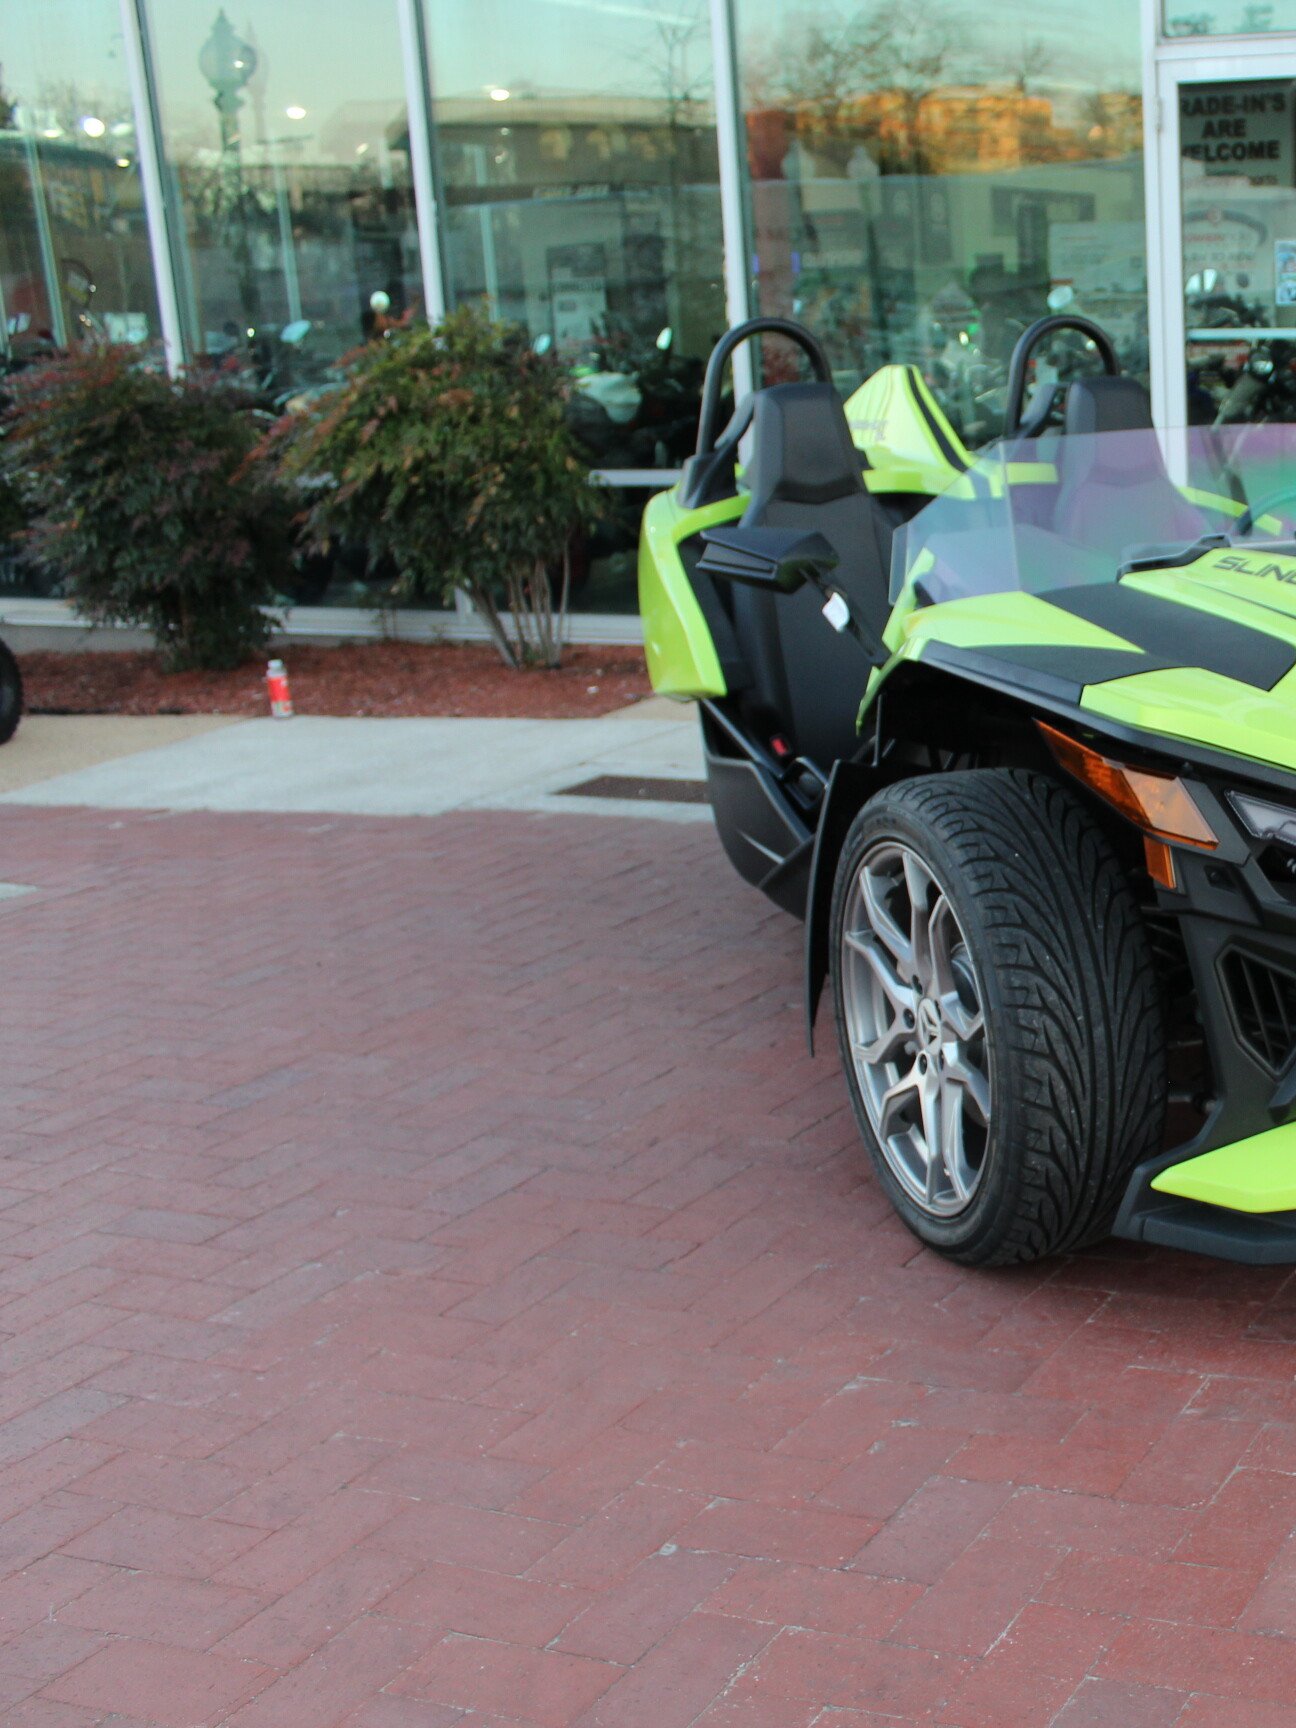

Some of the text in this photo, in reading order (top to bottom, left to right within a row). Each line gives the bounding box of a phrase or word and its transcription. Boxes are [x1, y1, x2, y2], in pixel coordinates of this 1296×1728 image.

[1181, 92, 1285, 116] RADE-IN'S
[1201, 118, 1246, 139] ARE
[1181, 140, 1280, 162] ELCOME
